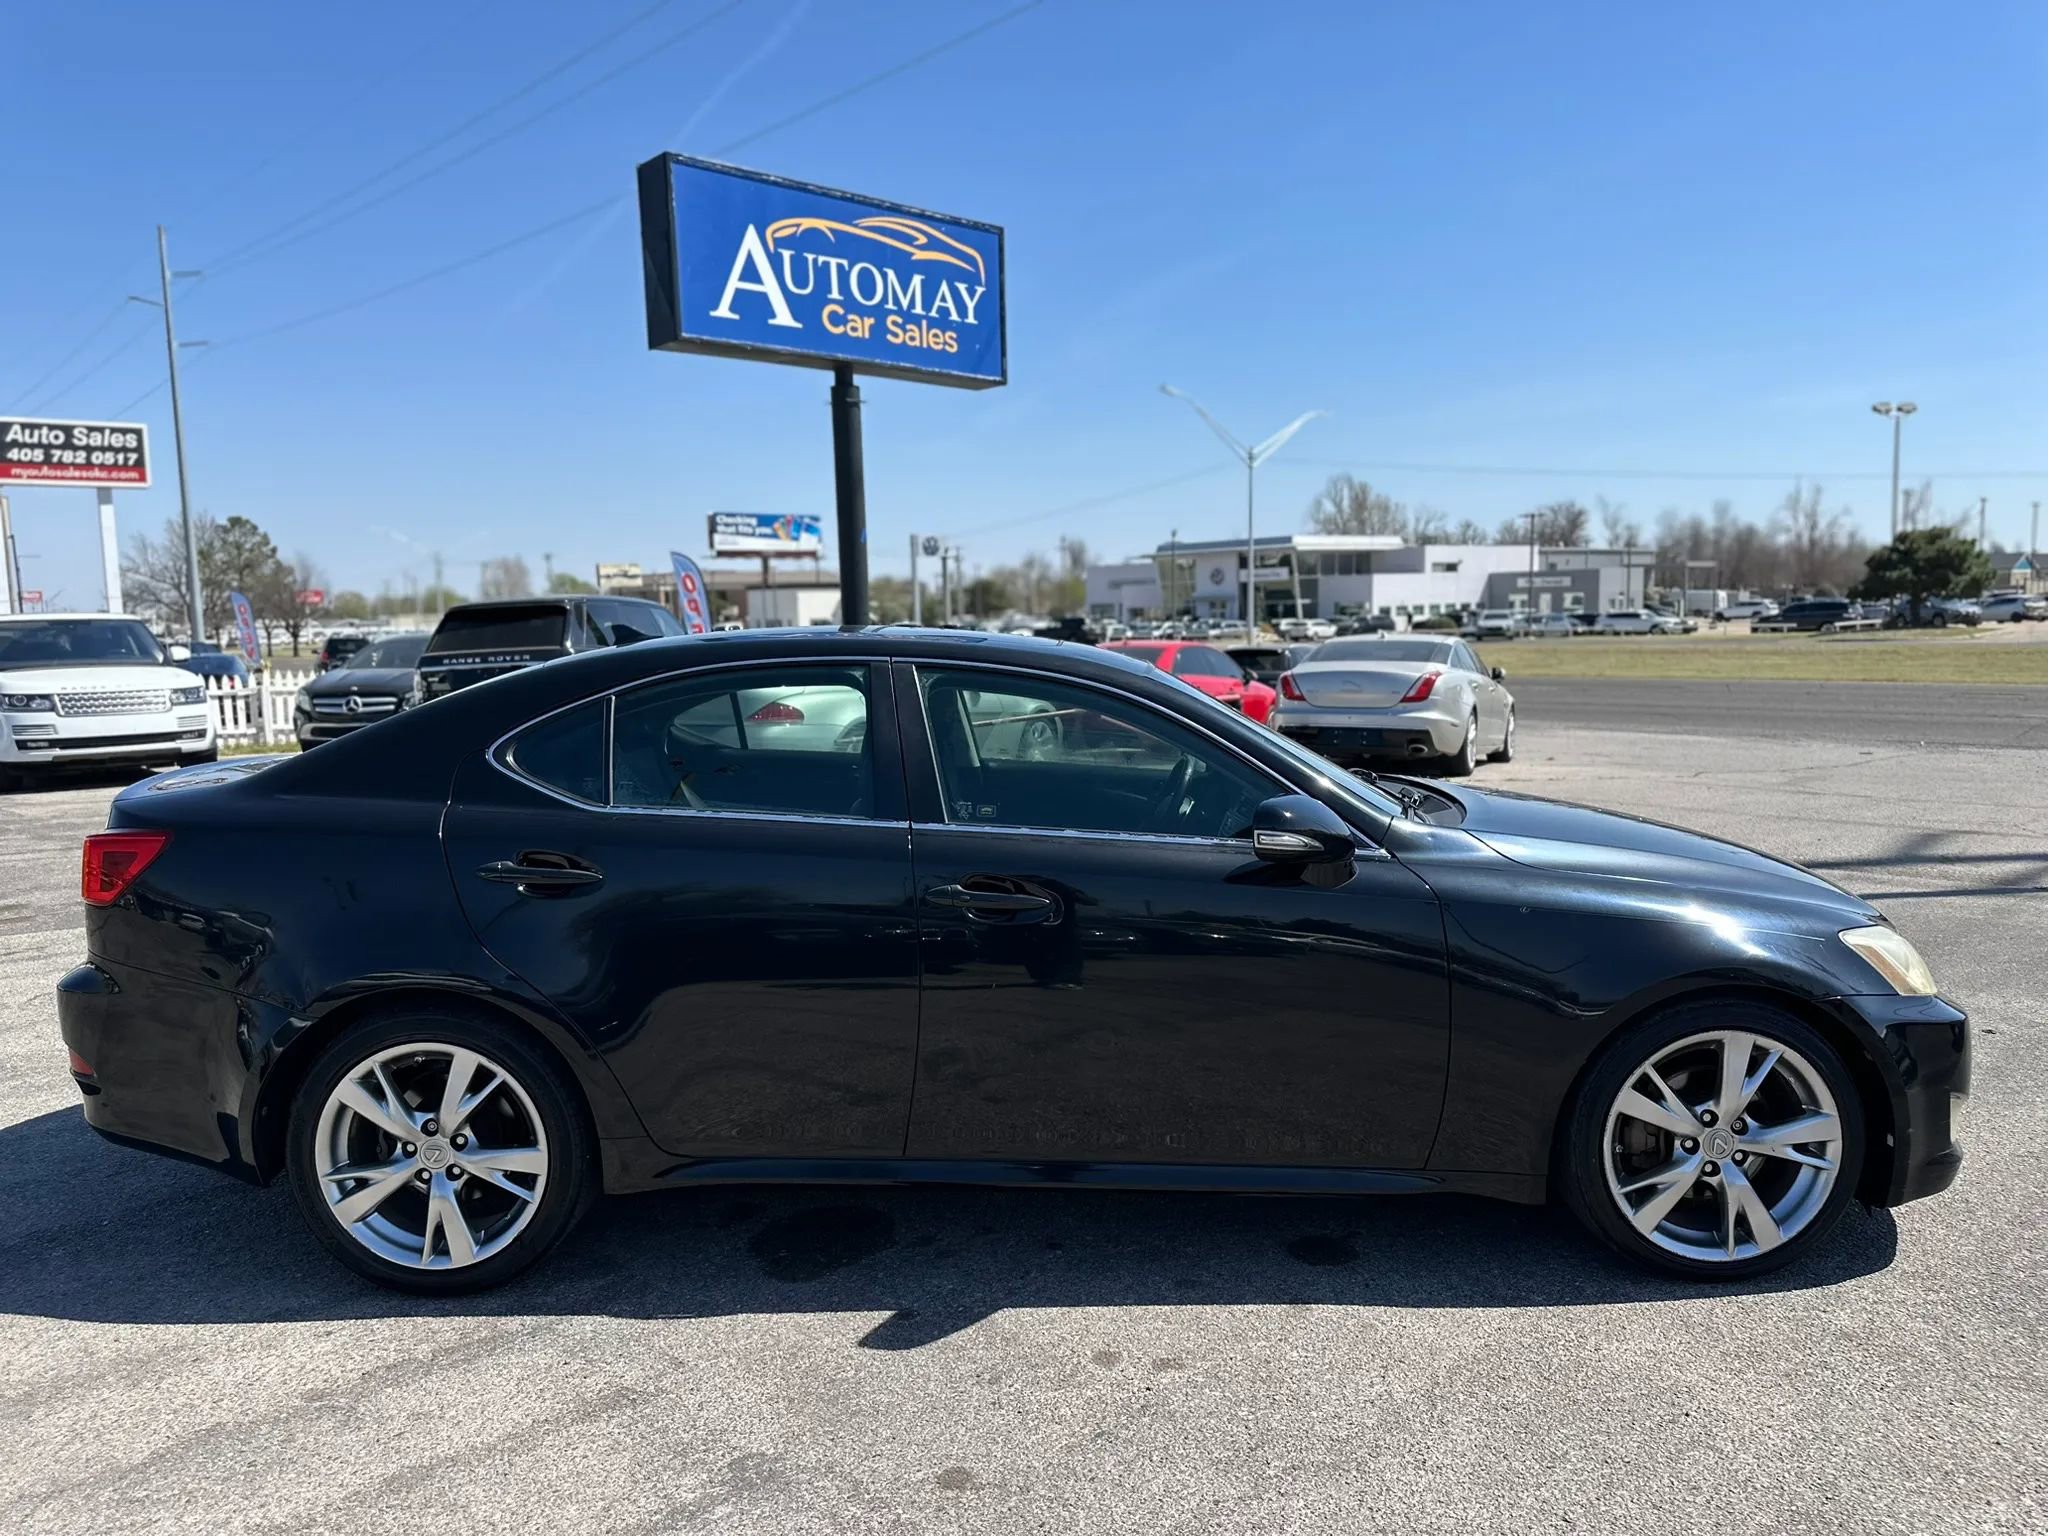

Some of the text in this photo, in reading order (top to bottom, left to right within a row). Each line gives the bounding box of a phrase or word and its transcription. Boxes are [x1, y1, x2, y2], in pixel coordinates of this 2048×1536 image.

[709, 223, 986, 329] AUTOMAY
[821, 303, 959, 353] Car Sales
[5, 423, 138, 449] Auto Sales
[6, 447, 139, 467] 405 782 0517
[442, 657, 481, 665] RANGE
